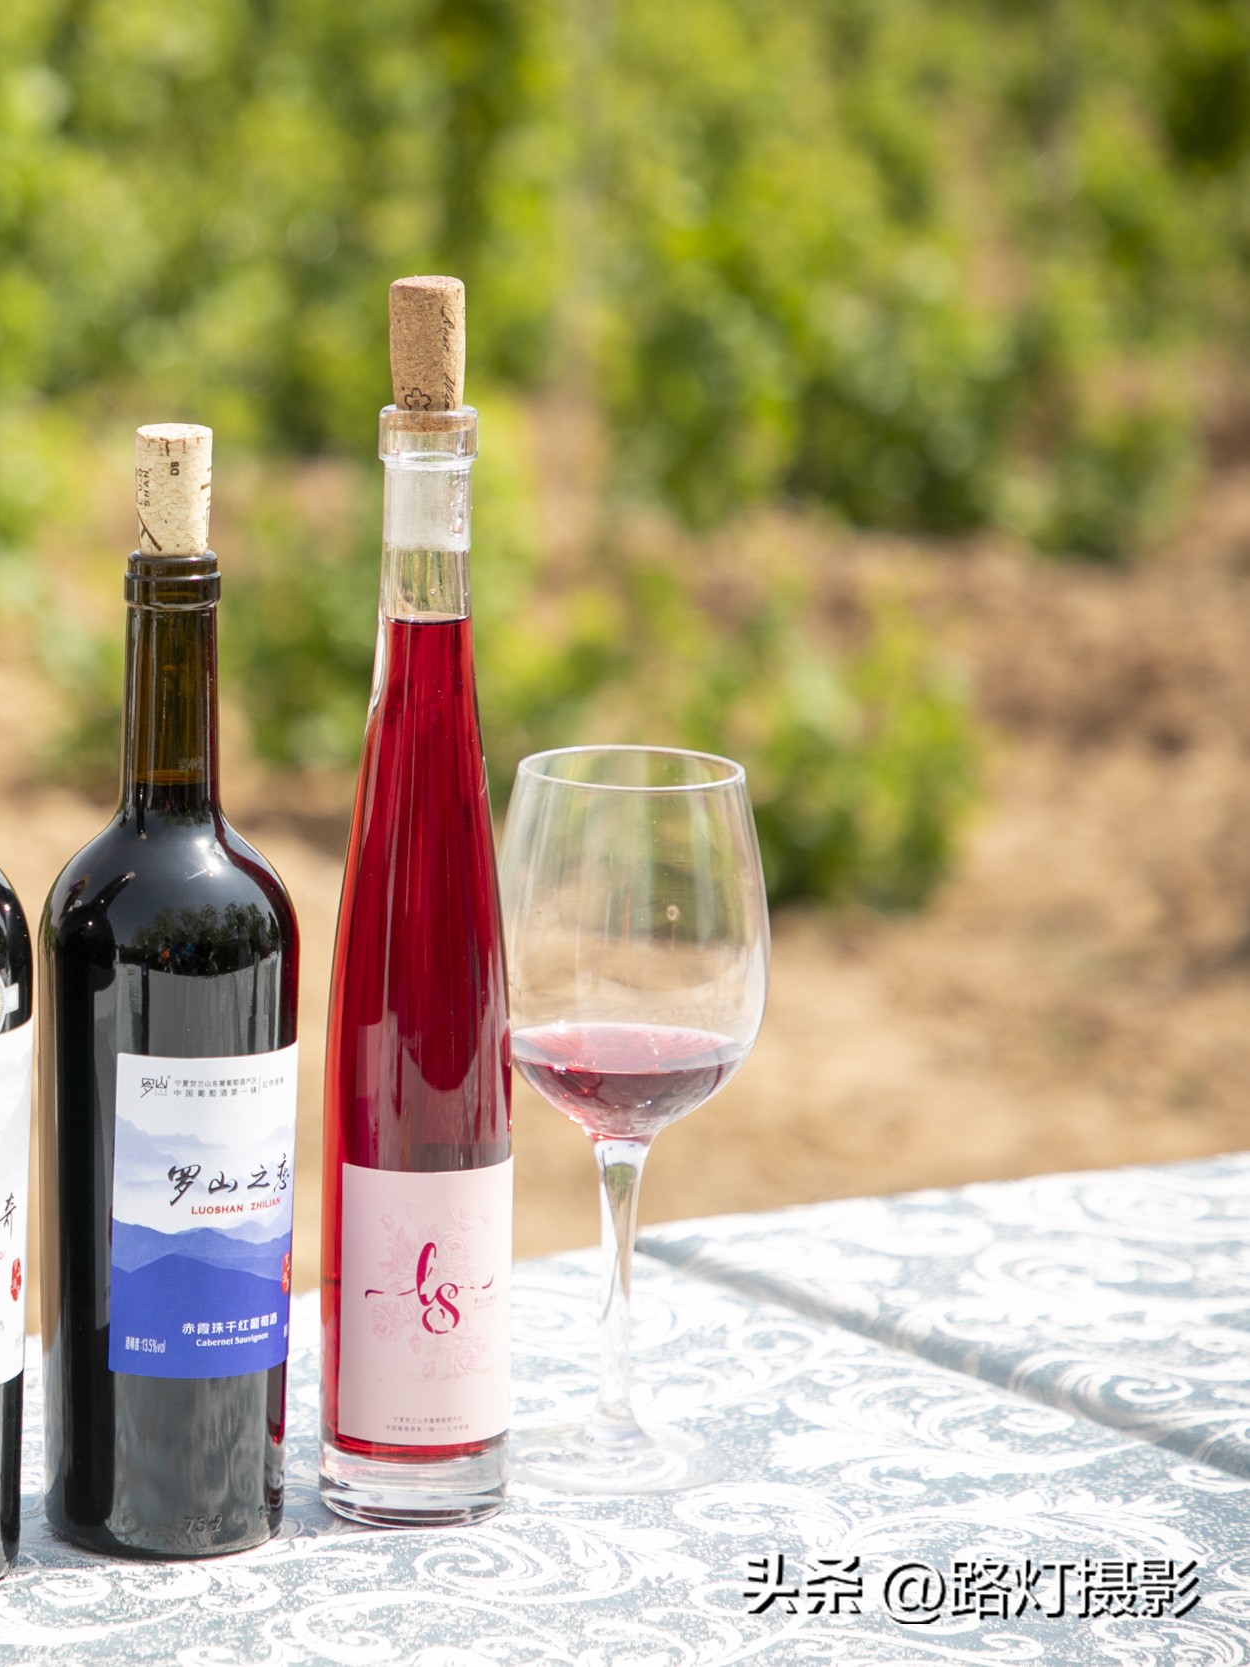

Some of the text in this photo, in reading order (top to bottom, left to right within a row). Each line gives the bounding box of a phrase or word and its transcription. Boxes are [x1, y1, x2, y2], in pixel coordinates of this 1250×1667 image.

[190, 1196, 281, 1215] LUOSHAN ZHILIAN
[181, 1311, 278, 1336] 赤霞珠干红葡萄酒
[195, 1331, 269, 1347] Cabernet Sauvignon
